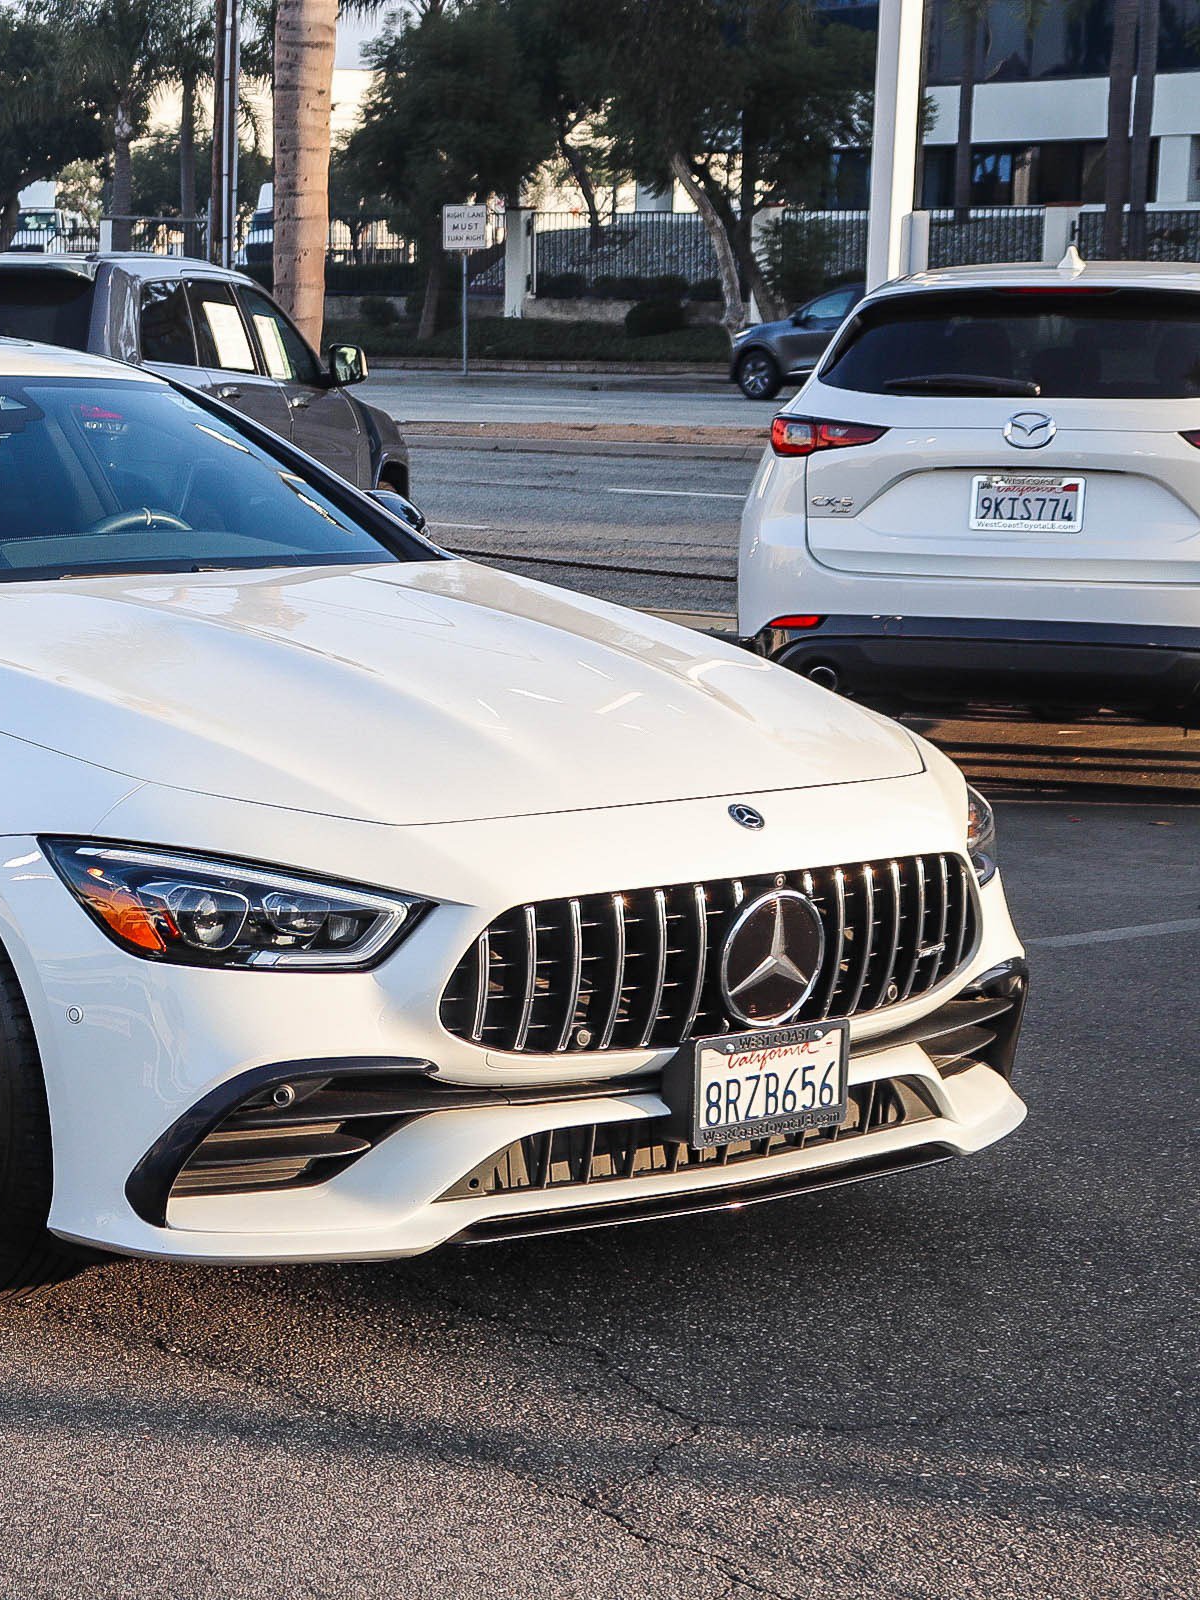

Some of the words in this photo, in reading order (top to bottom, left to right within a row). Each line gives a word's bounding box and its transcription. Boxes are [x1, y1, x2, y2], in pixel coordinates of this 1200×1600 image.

[452, 223, 479, 231] MUST
[811, 495, 854, 507] CX-5
[980, 496, 1074, 521] 9KIS774
[739, 1034, 771, 1050] WEST
[773, 1027, 812, 1046] COAST
[727, 1042, 820, 1071] California
[705, 1060, 836, 1127] 8RZB656
